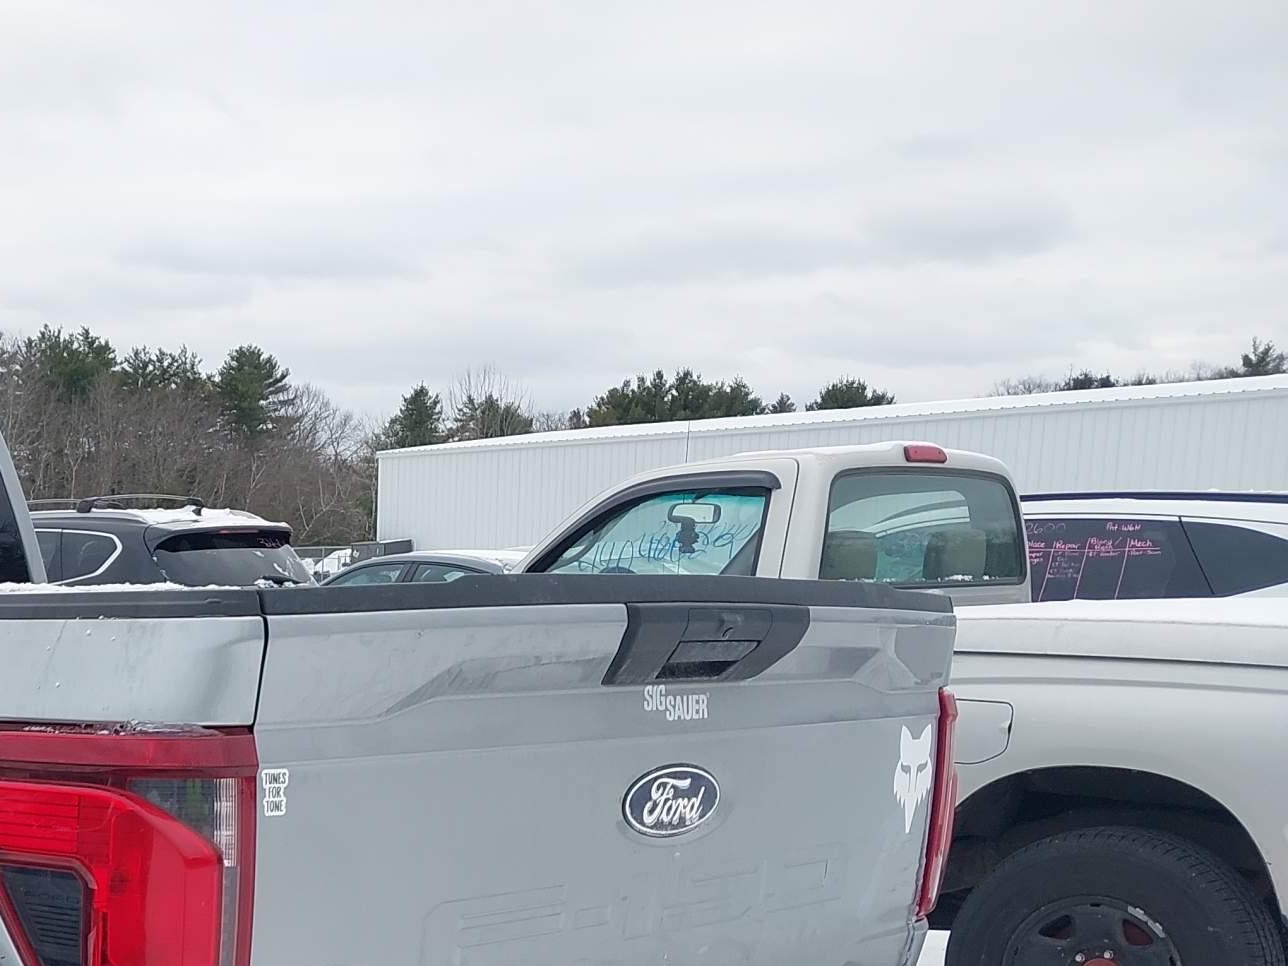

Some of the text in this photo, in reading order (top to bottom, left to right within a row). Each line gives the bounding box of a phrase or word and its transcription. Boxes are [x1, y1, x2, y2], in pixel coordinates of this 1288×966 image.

[643, 684, 666, 711] SIG
[666, 694, 708, 721] SAUER
[263, 772, 287, 785] TUNES
[268, 786, 282, 799] FOR
[643, 777, 705, 826] Ford
[265, 800, 284, 813] TONE
